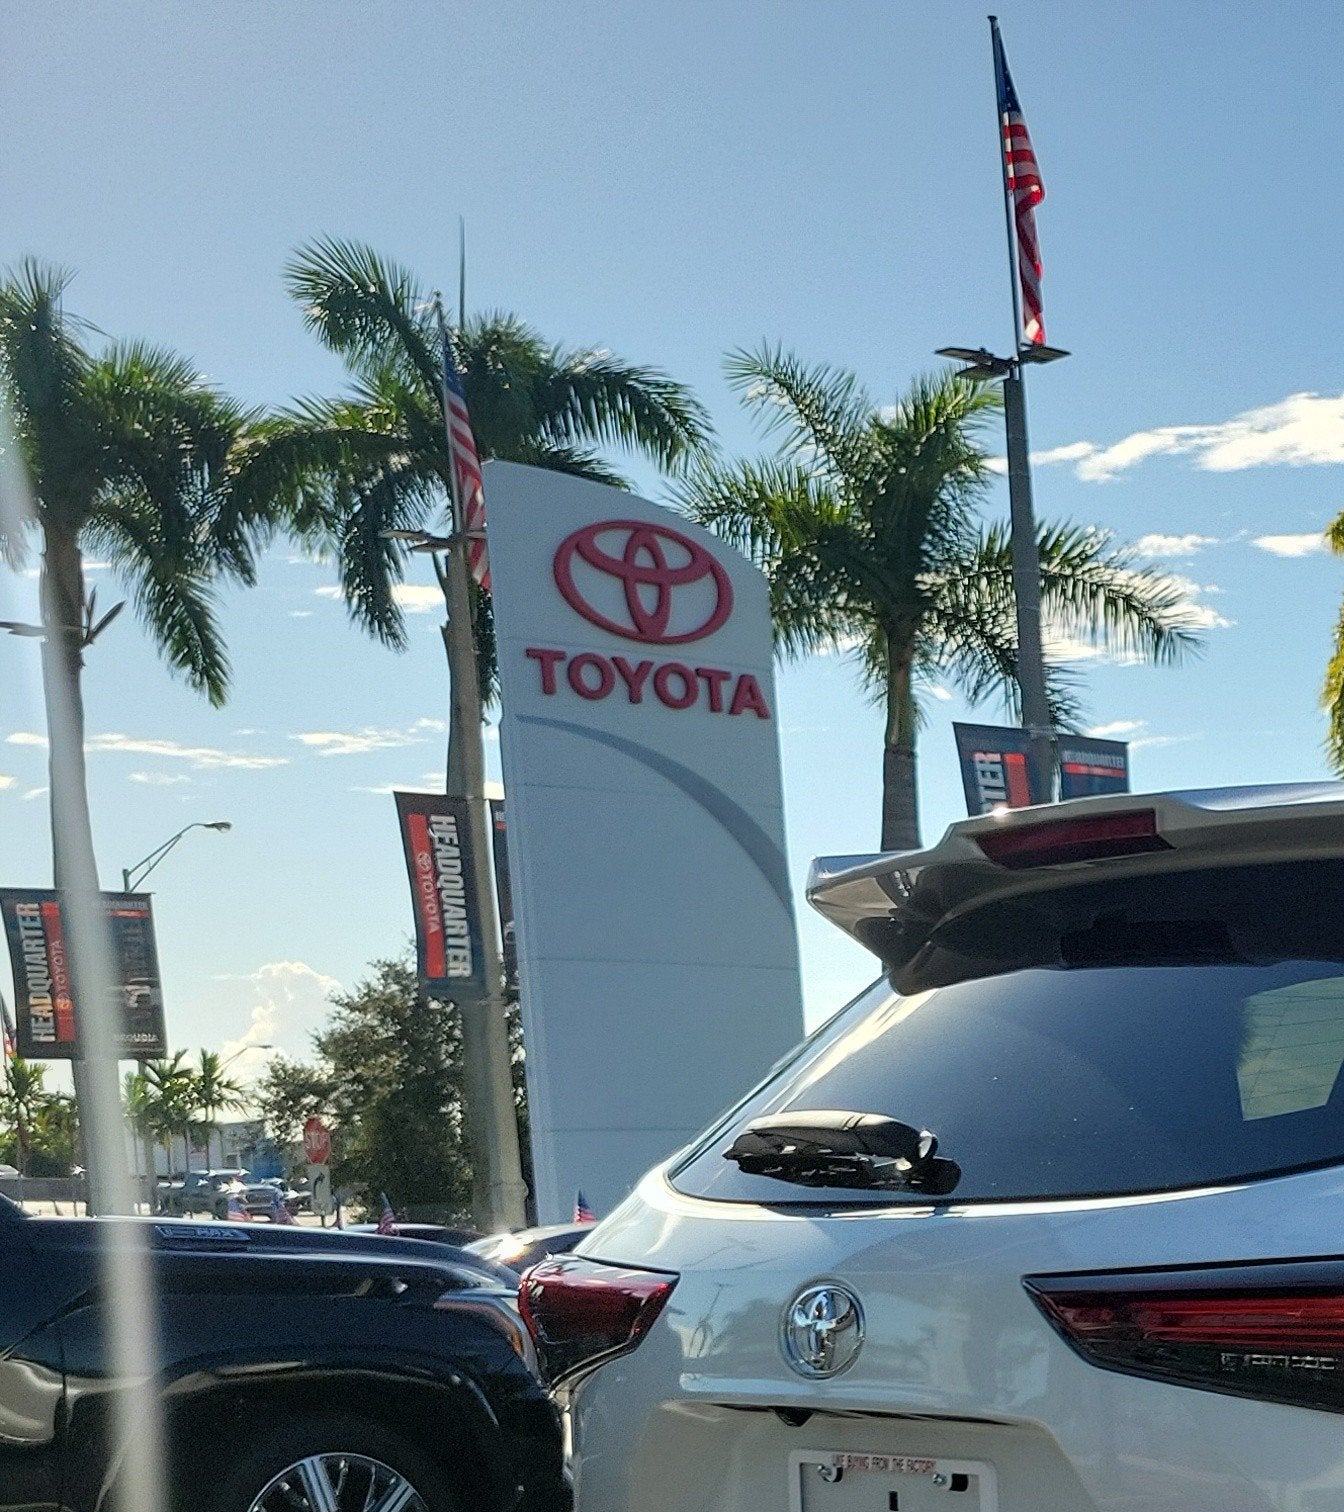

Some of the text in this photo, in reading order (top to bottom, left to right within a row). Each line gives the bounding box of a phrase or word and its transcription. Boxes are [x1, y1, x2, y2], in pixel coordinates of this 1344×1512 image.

[525, 647, 771, 720] TOYOTA
[421, 873, 442, 933] TOYOTA
[430, 815, 474, 977] HEADQUARTER
[16, 903, 56, 1042] HEADQUARTER
[51, 940, 70, 992] TOYOTA
